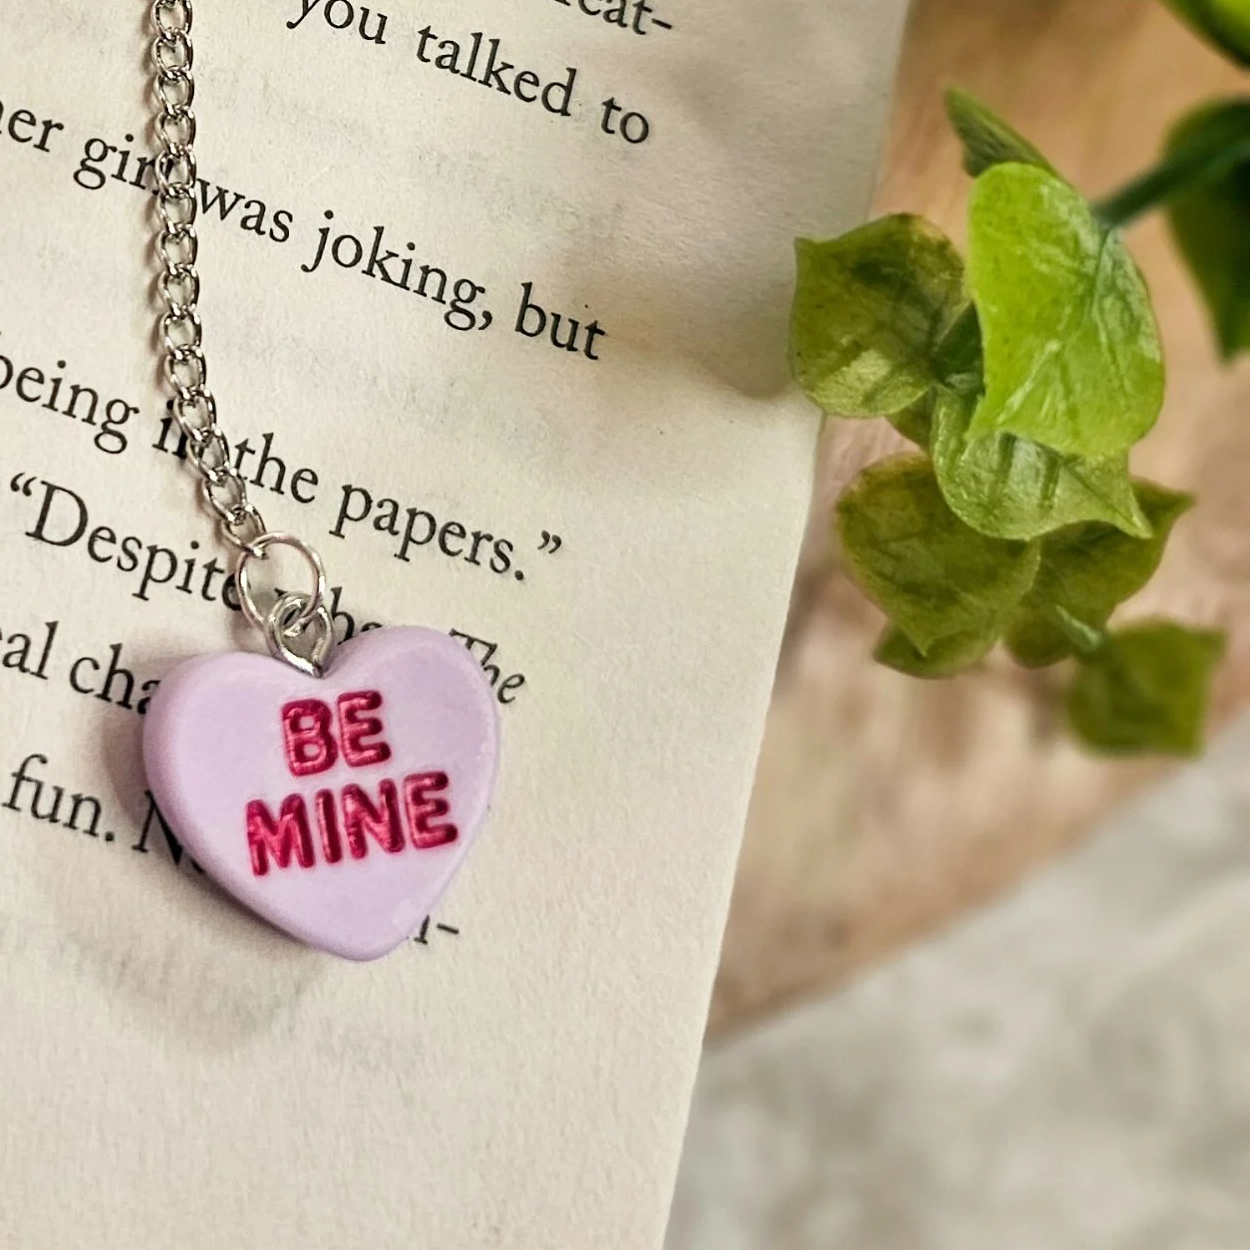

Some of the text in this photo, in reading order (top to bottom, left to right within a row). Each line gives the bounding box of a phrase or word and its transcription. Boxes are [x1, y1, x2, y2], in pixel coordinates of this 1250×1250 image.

[416, 25, 577, 117] talked
[601, 97, 649, 144] to
[196, 177, 295, 245] was
[301, 210, 493, 331] joking,
[515, 282, 608, 360] but
[235, 432, 320, 506] the
[329, 484, 562, 582] papers.”
[280, 689, 392, 777] BE
[1, 753, 117, 843] fun.
[245, 771, 459, 877] MINE
